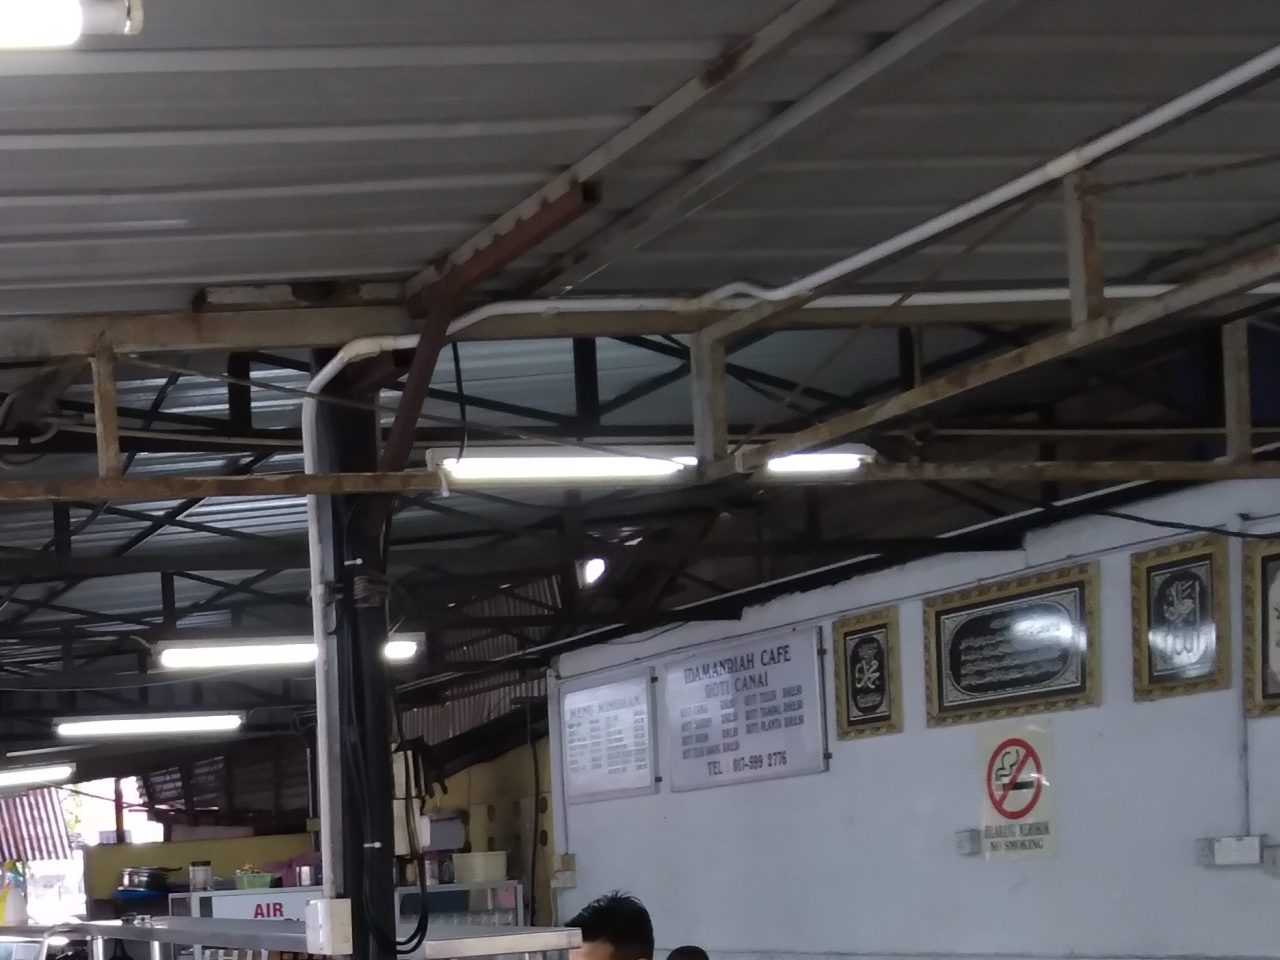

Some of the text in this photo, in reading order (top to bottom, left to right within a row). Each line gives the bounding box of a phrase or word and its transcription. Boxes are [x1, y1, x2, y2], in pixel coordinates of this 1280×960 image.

[760, 645, 792, 667] CAFE
[705, 680, 730, 699] ROTI
[734, 671, 769, 692] CANAI
[707, 761, 723, 776] TEL
[990, 838, 1044, 852] NO SMOKING
[253, 902, 285, 918] AIR
